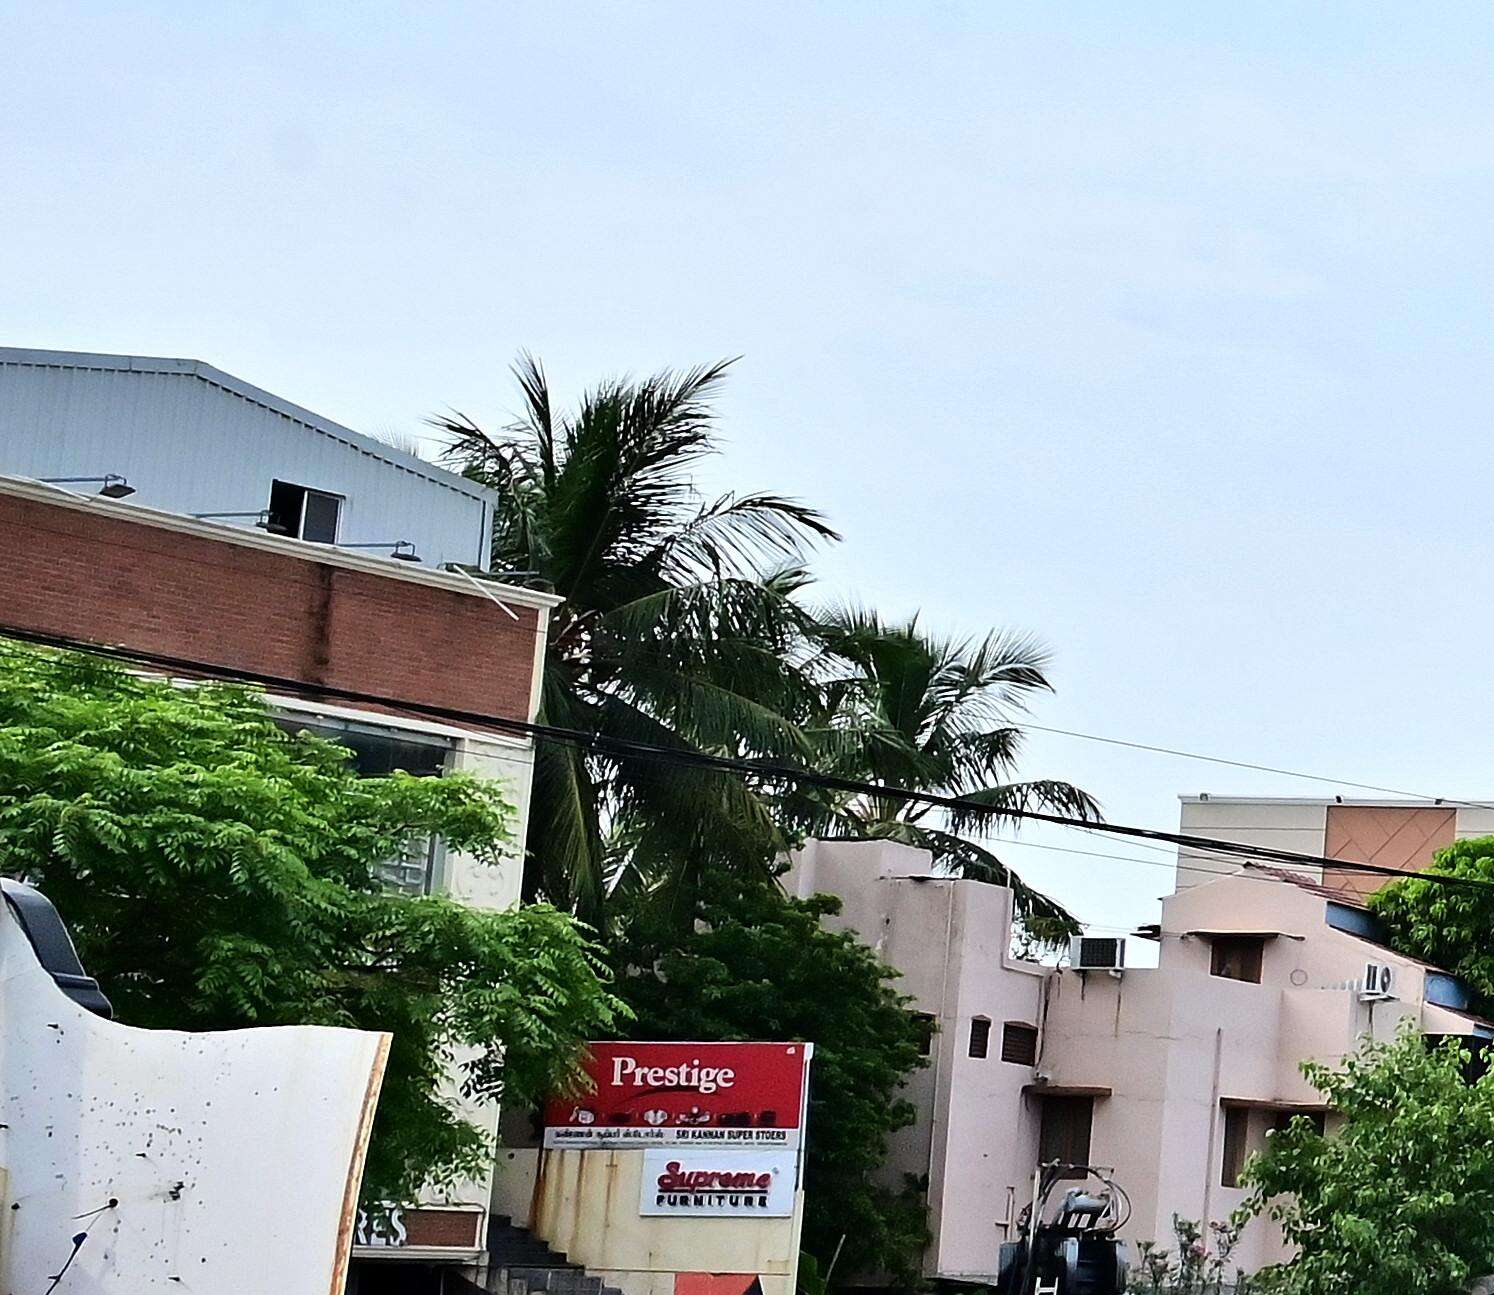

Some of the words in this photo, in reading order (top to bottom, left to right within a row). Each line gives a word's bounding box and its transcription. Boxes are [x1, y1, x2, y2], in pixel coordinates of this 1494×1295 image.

[611, 1056, 735, 1094] Prestige
[676, 1130, 689, 1139] SRI
[691, 1130, 726, 1140] KANNAN
[727, 1130, 753, 1140] SUPER
[657, 1161, 771, 1192] Supreme
[656, 1194, 768, 1208] FURNITURE
